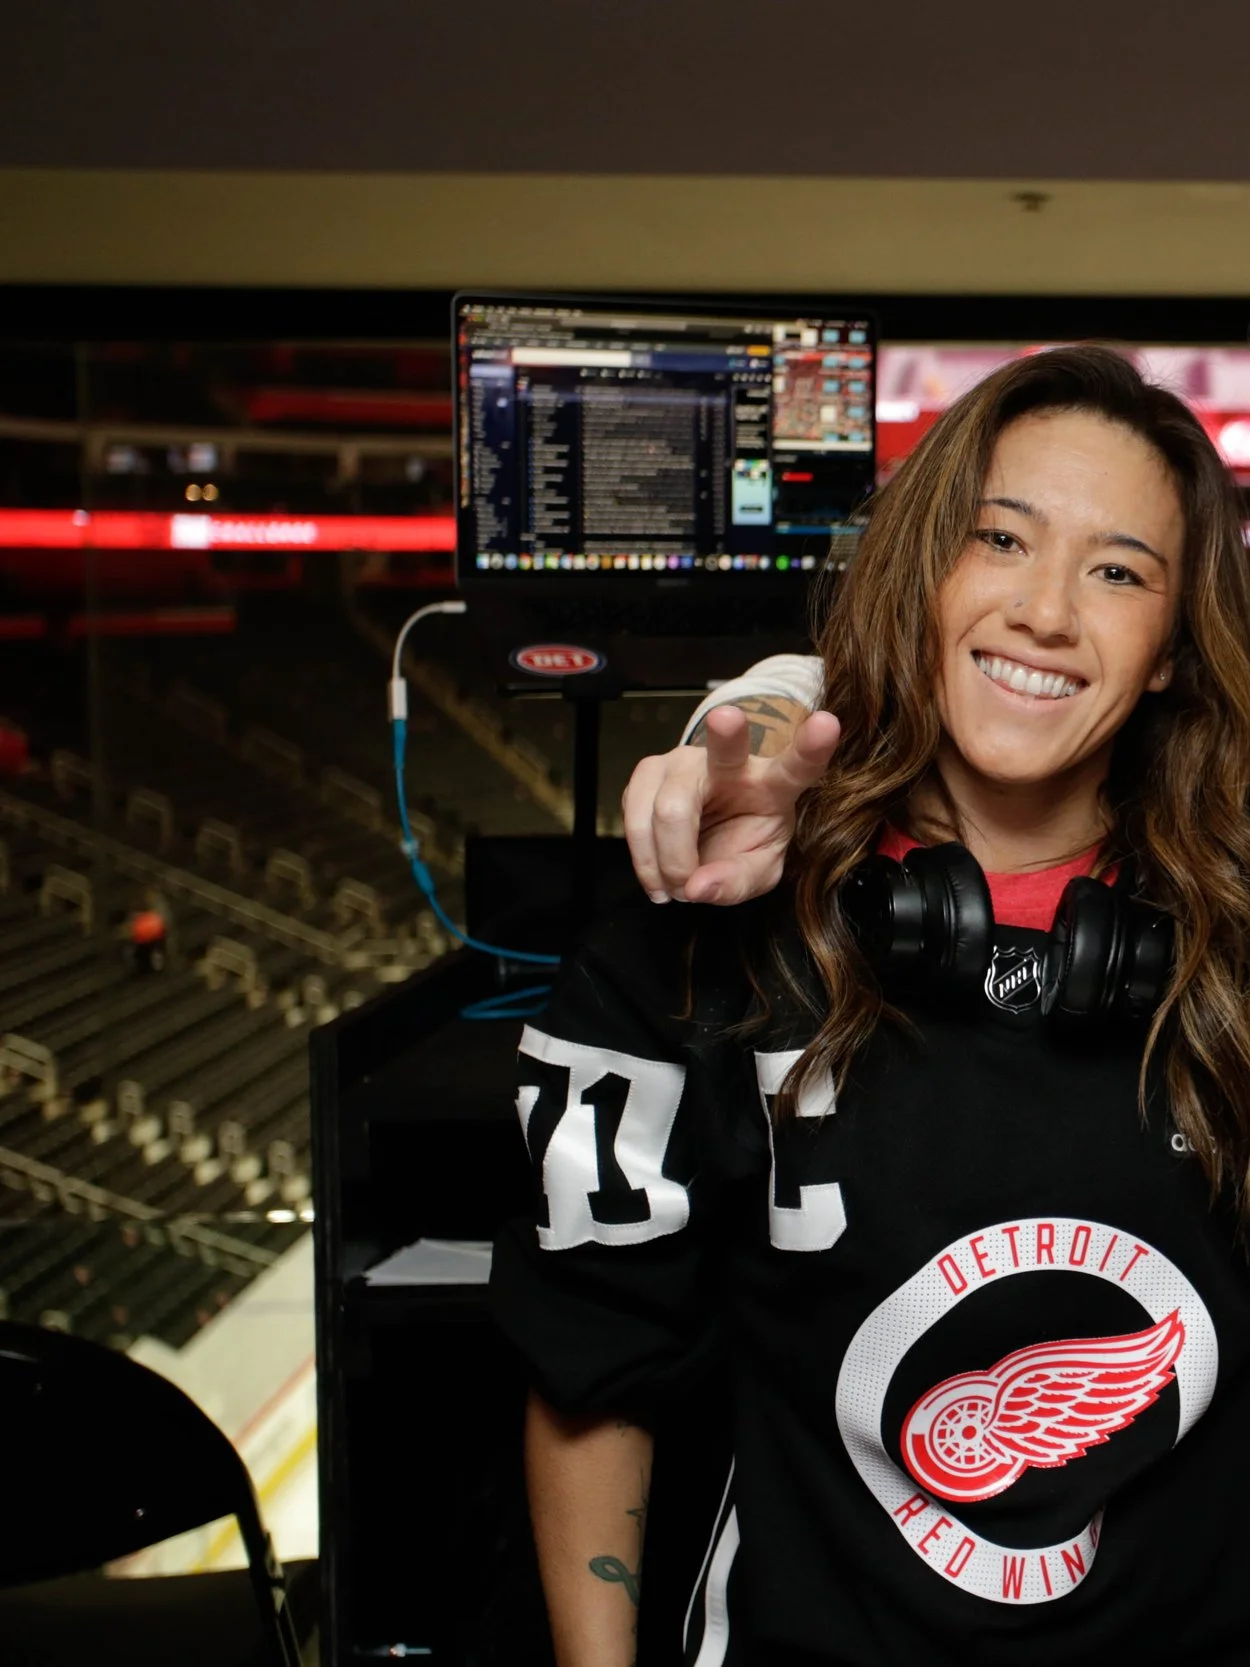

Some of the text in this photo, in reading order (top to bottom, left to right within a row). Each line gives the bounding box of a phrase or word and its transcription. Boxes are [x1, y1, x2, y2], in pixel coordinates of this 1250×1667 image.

[999, 966, 1033, 998] NHL
[937, 1223, 1149, 1296] DETROIT
[893, 1493, 976, 1578] RED
